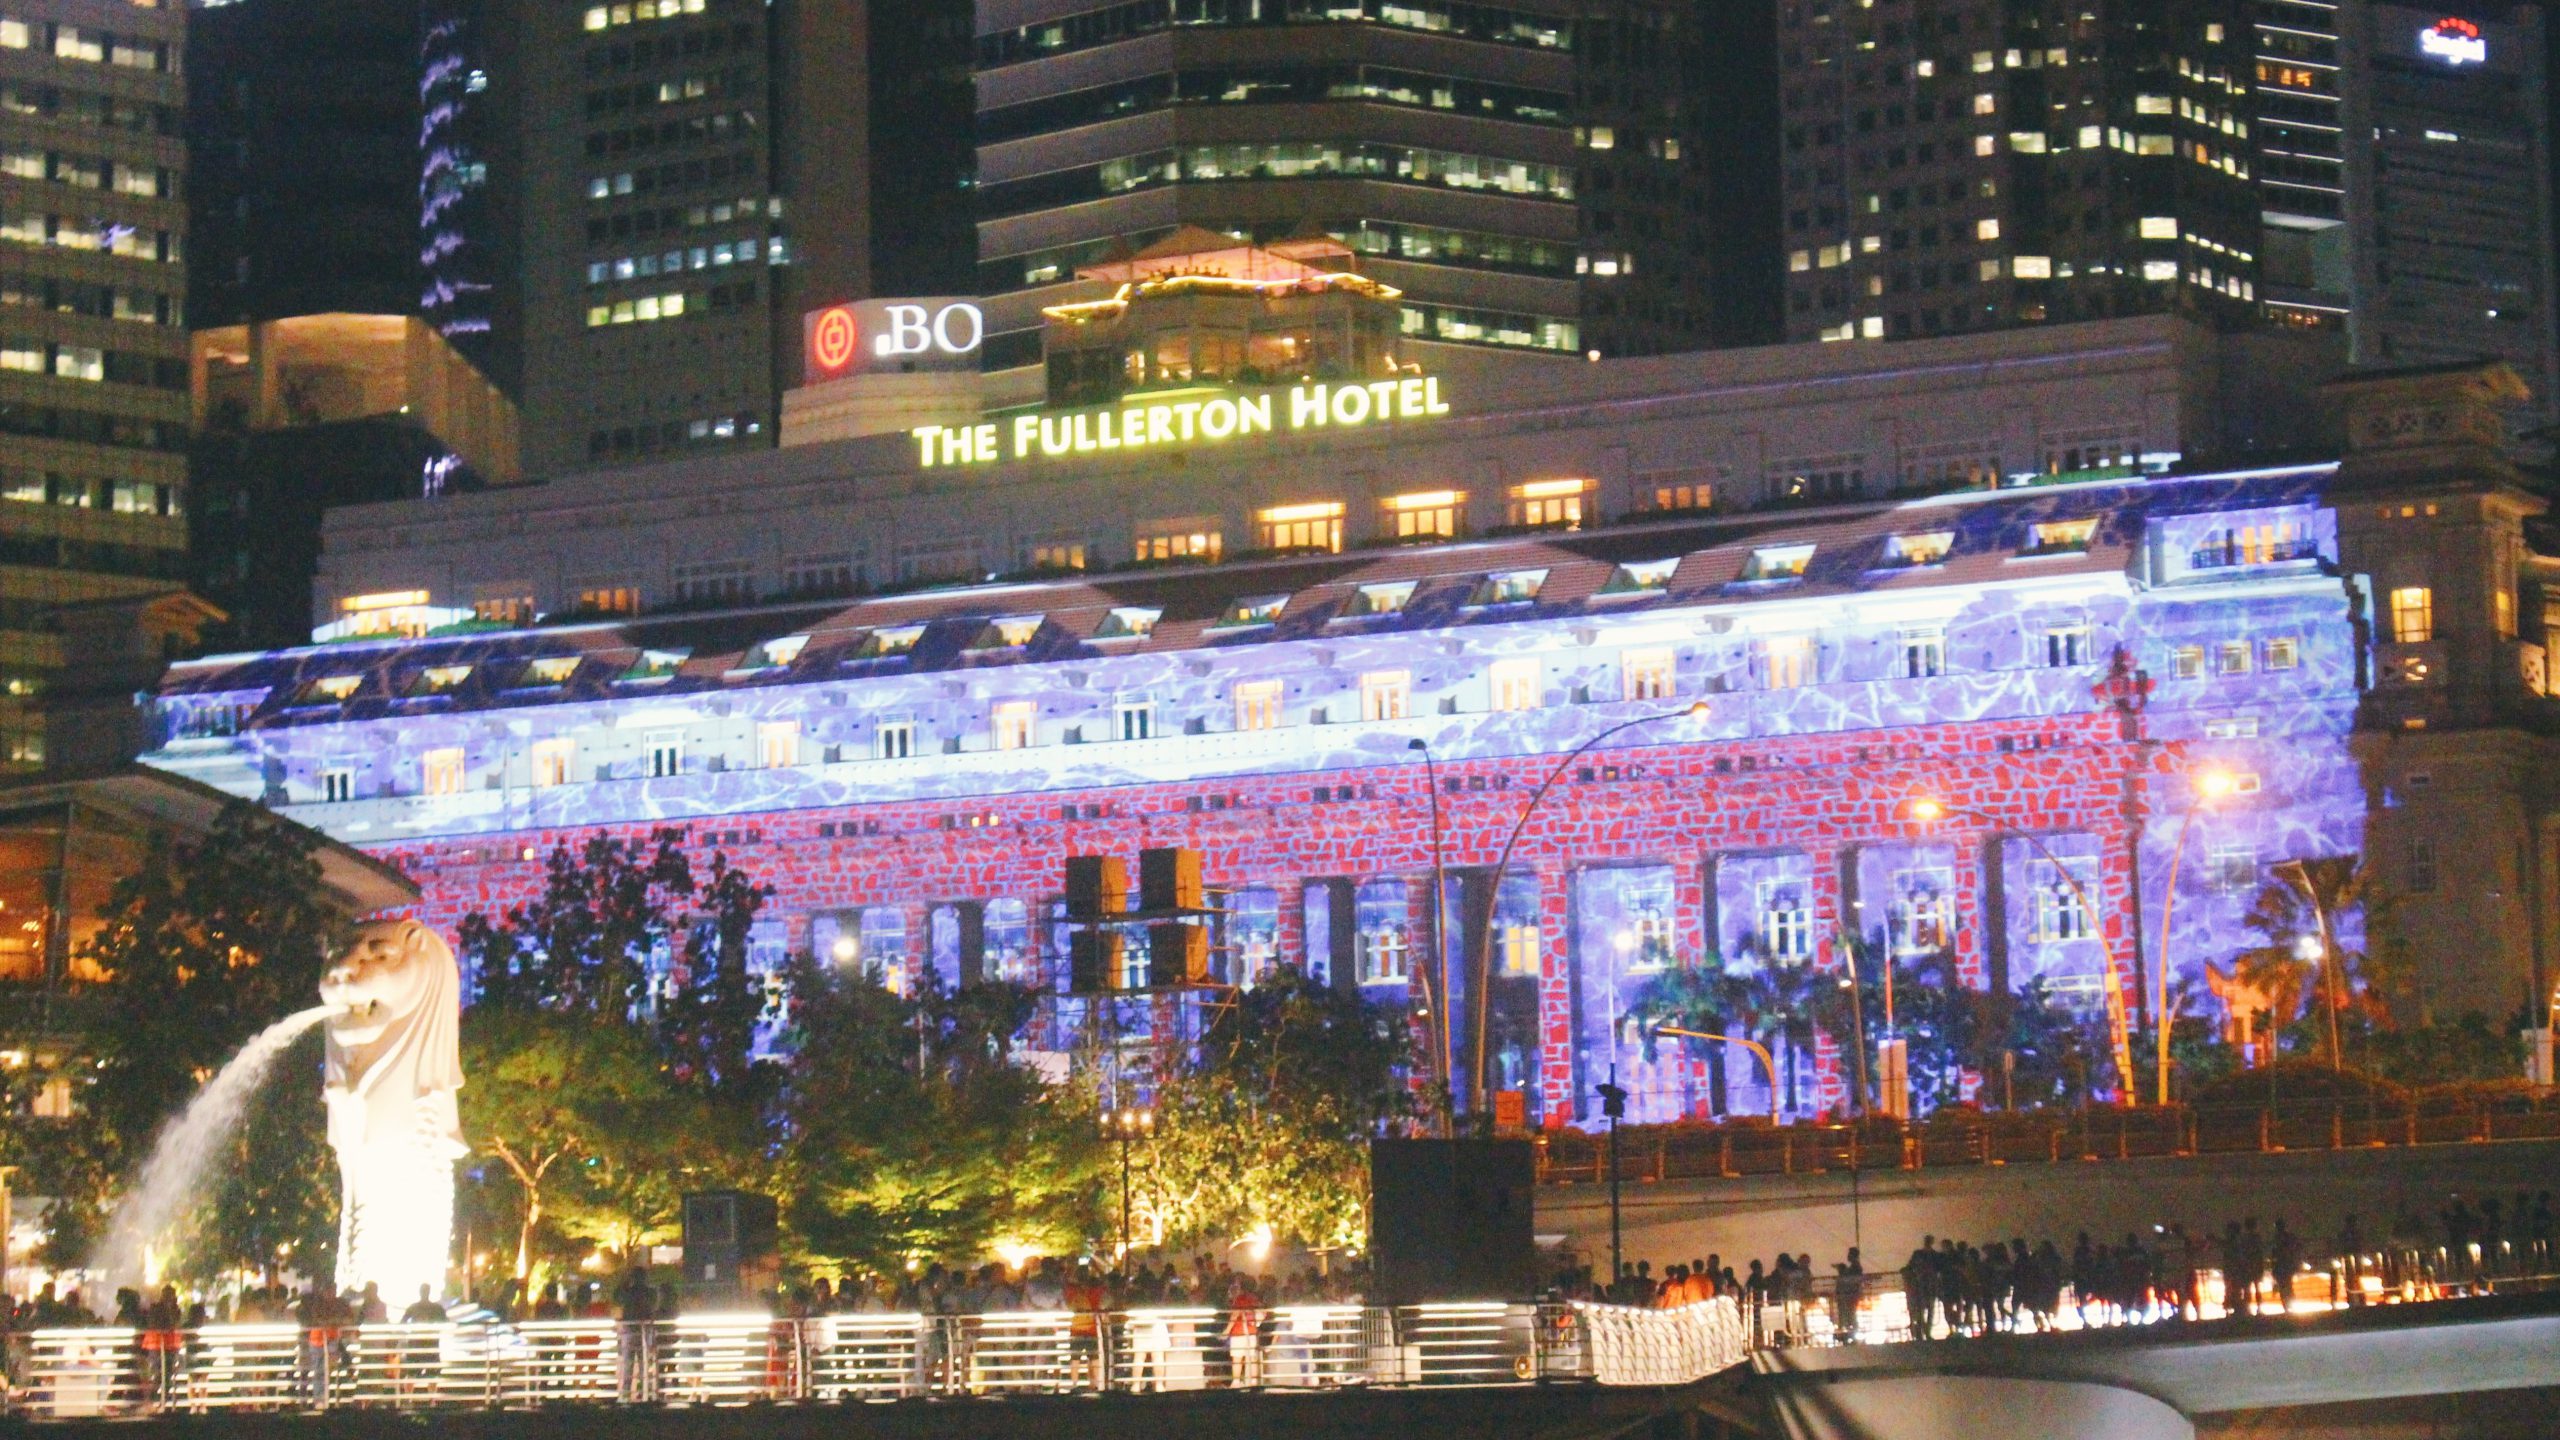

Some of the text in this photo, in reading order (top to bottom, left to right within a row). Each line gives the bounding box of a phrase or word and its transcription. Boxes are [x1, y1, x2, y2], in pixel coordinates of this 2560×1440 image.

[912, 376, 1450, 468] THE FULLERTON HOTEL
